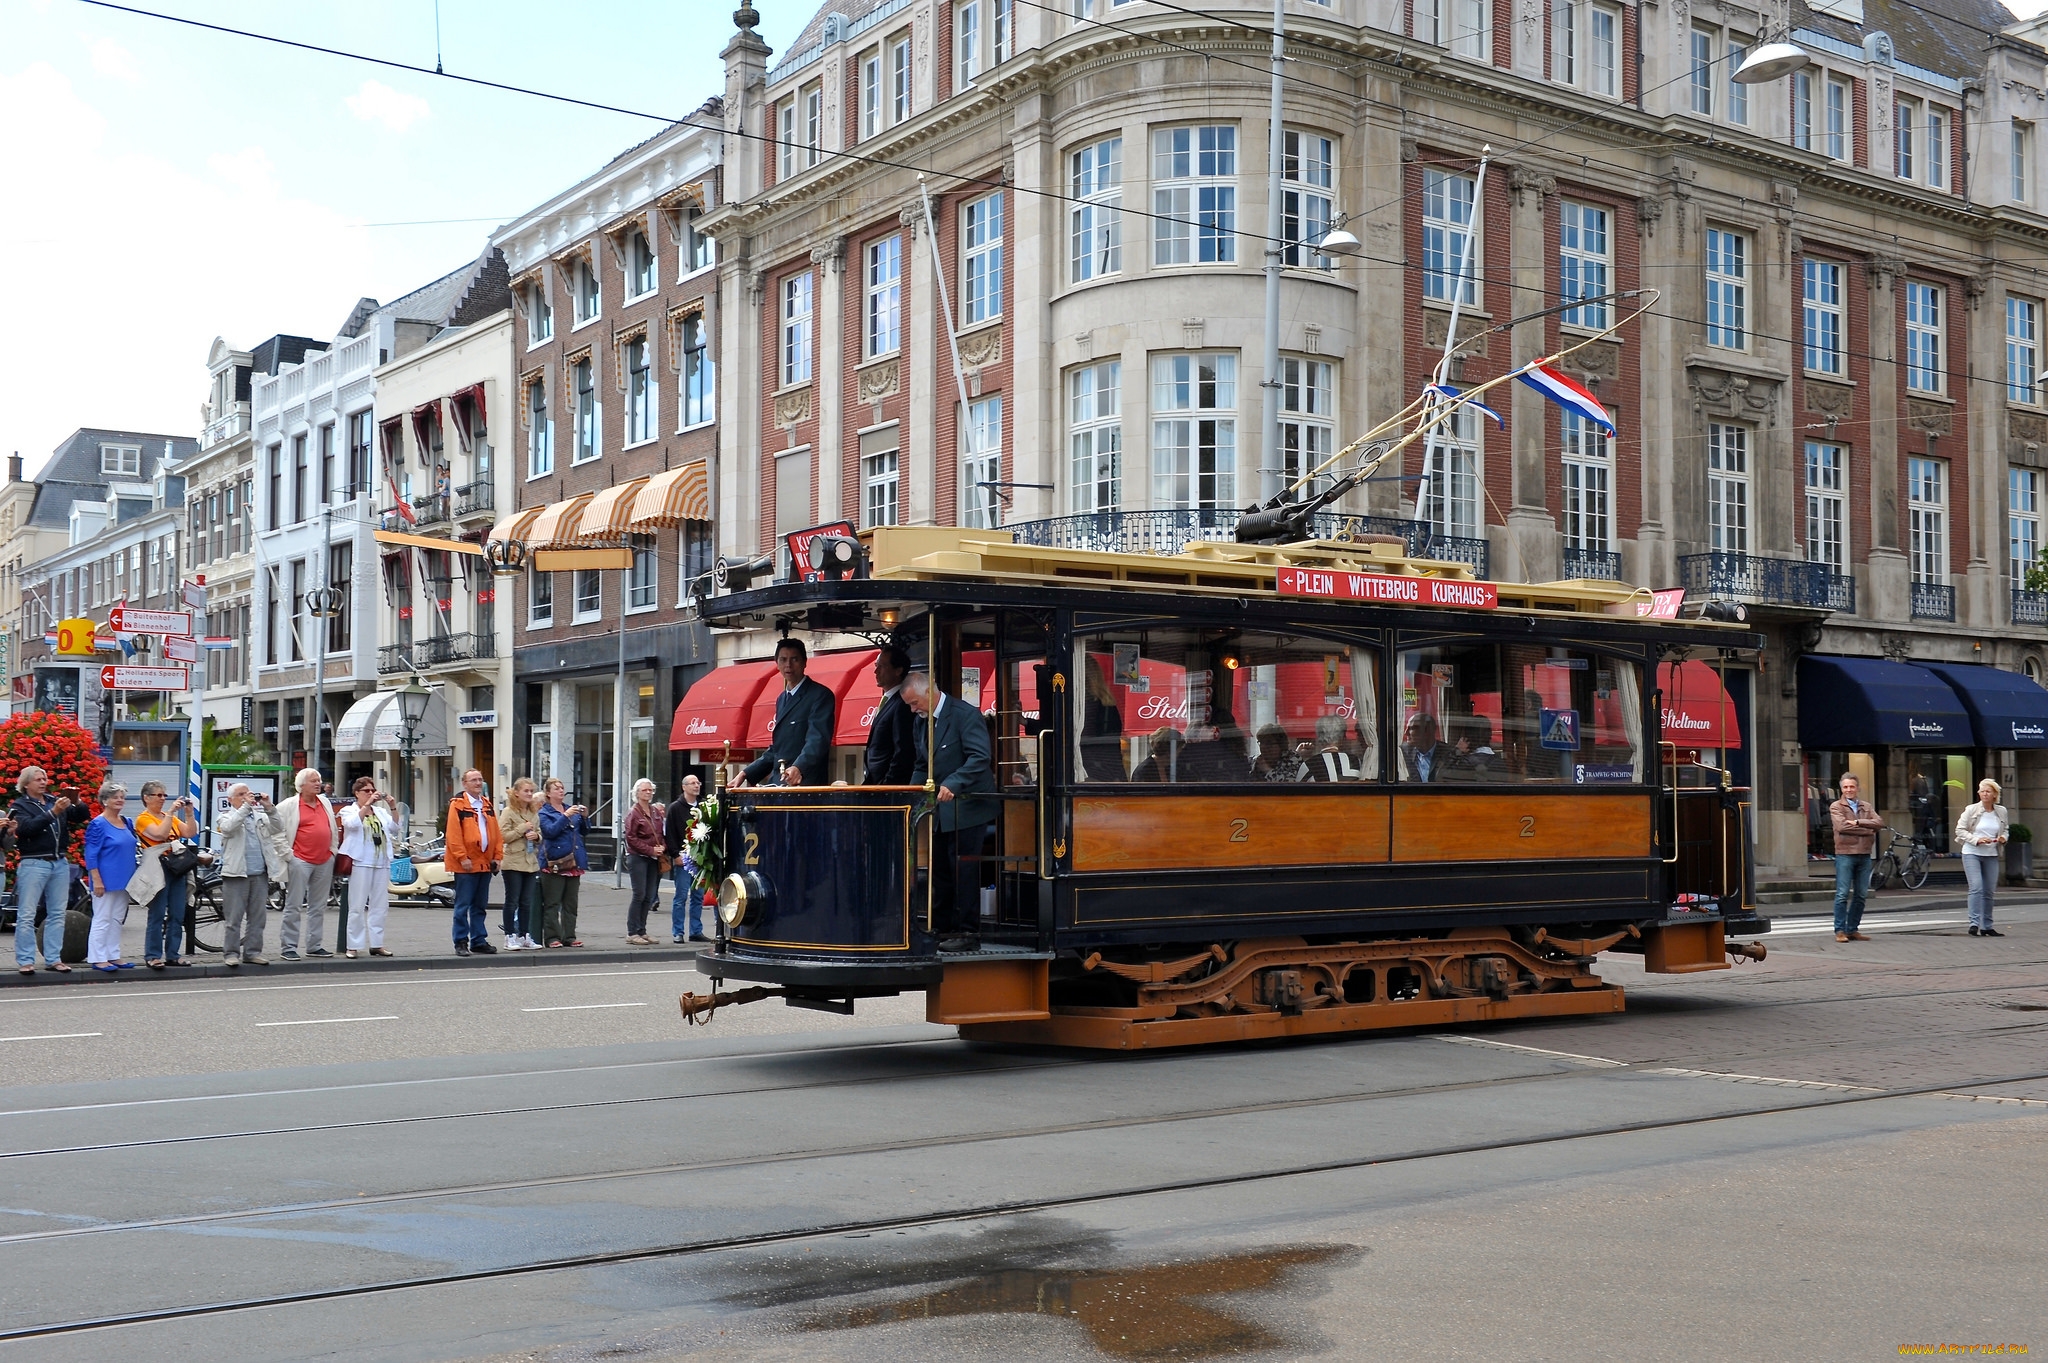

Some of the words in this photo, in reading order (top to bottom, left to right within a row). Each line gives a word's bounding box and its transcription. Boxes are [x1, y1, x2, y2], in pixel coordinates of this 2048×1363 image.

[808, 574, 815, 583] 5
[1296, 571, 1334, 595] PLEIN
[1348, 575, 1418, 601] WITTEBRUG
[1431, 581, 1485, 605] KURHAUS
[133, 612, 171, 621] Buitenhof
[133, 622, 172, 631] Binnenhof
[158, 670, 180, 678] Spoor
[1229, 818, 1249, 842] 2
[1519, 815, 1535, 837] 2
[744, 833, 759, 865] 2
